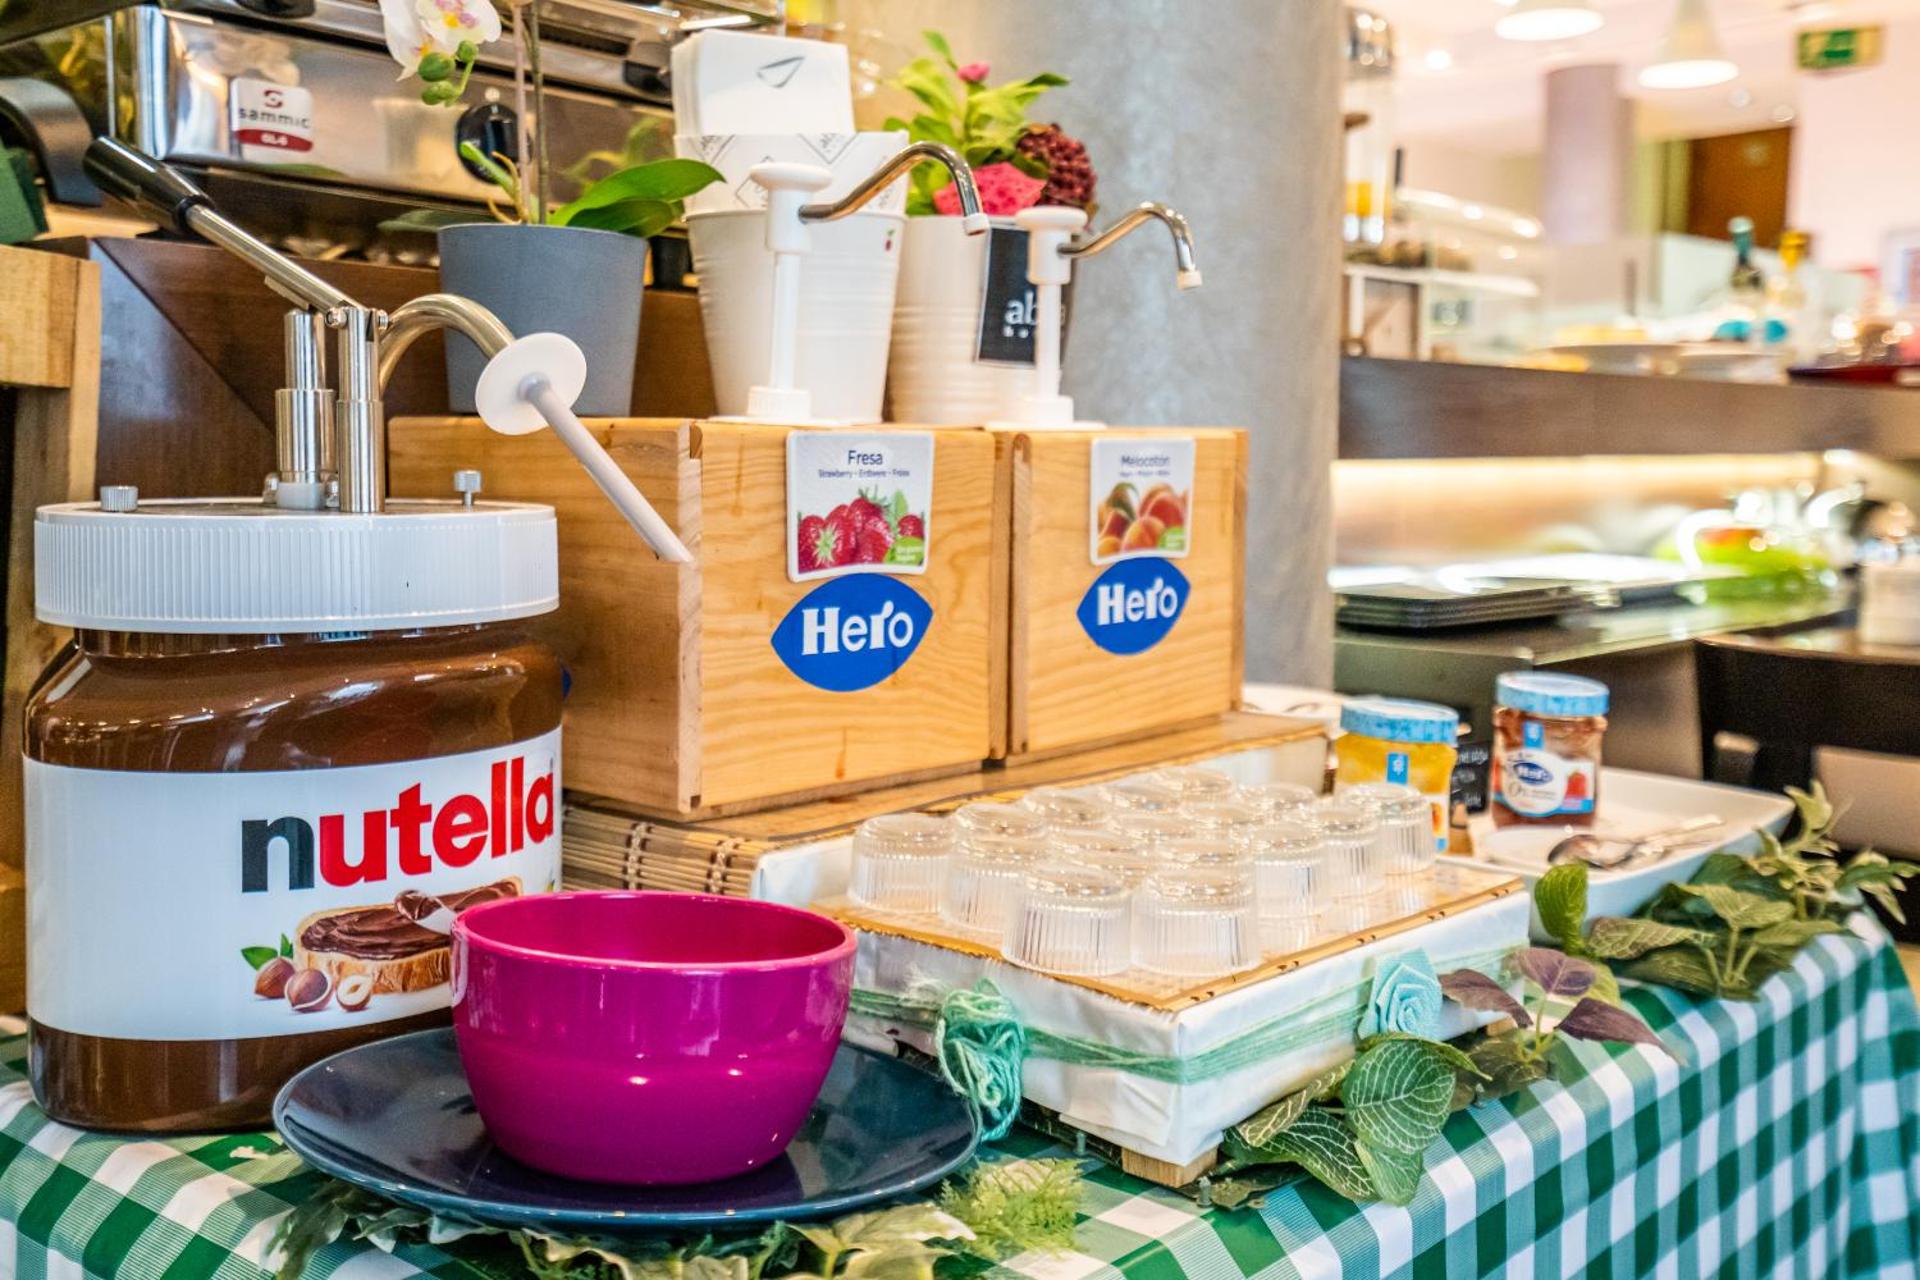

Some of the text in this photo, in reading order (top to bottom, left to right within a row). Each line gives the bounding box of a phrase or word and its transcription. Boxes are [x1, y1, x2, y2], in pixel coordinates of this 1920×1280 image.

[239, 108, 311, 129] sammic
[848, 450, 883, 465] Fresa
[1097, 578, 1178, 626] Hero
[801, 600, 914, 655] Hero
[242, 756, 554, 893] nutella
